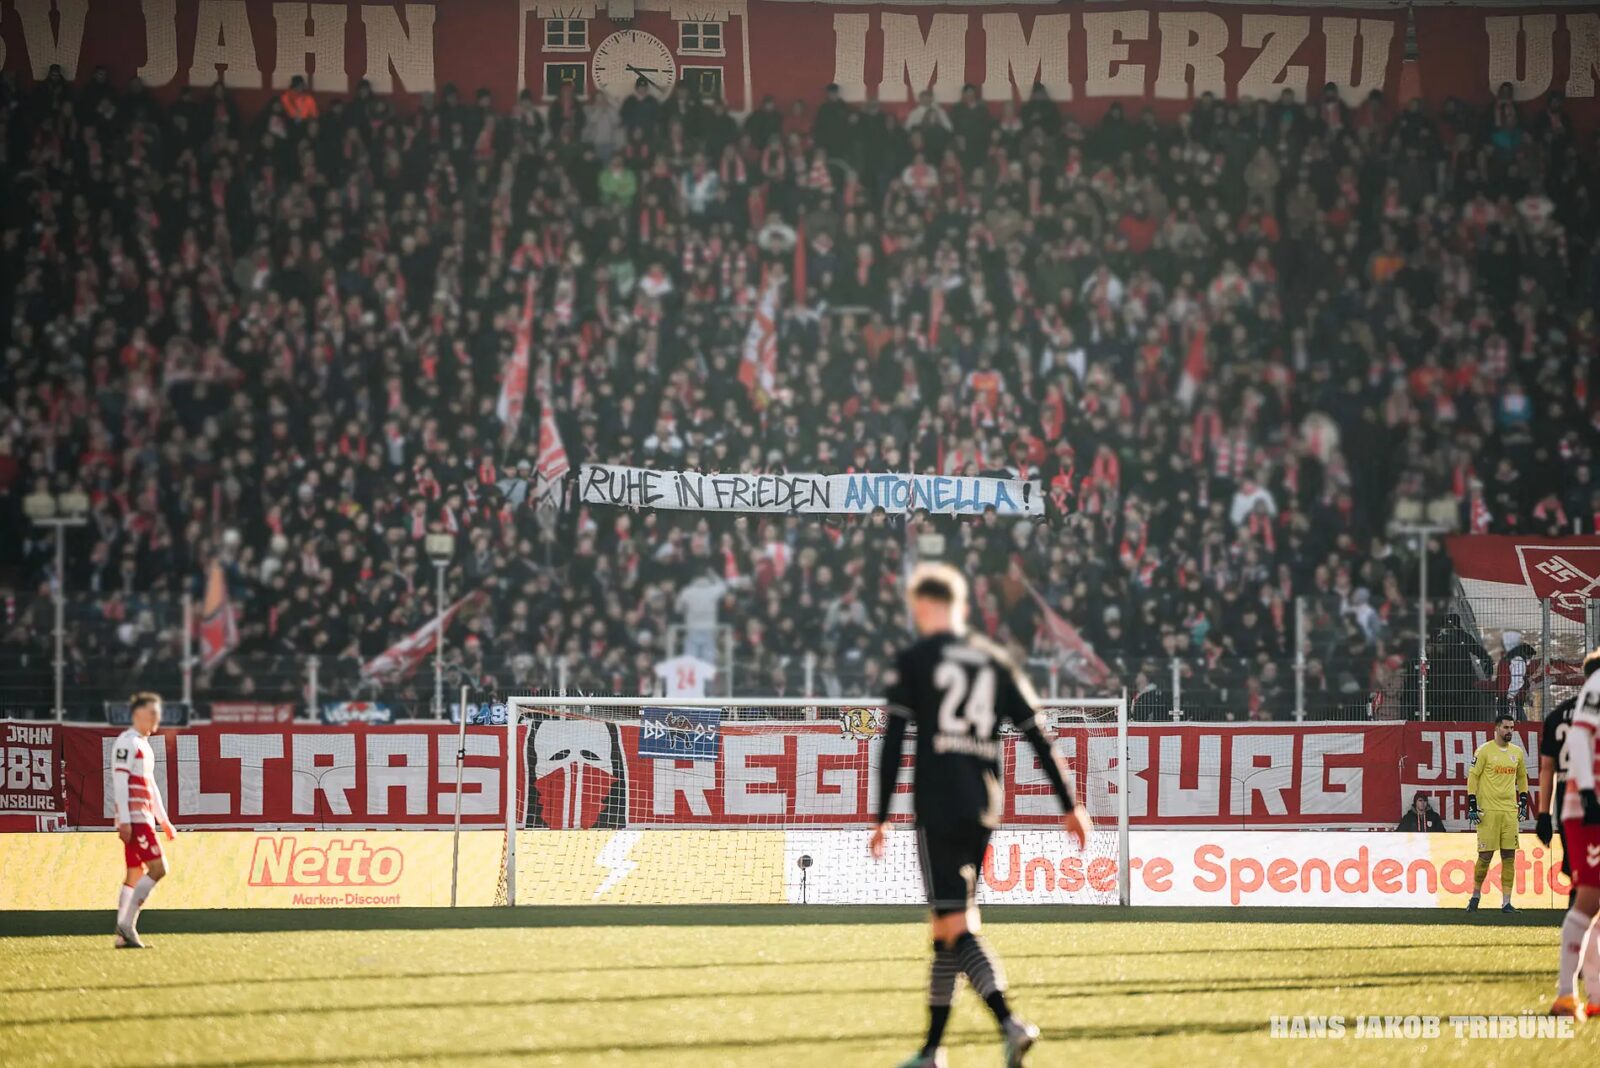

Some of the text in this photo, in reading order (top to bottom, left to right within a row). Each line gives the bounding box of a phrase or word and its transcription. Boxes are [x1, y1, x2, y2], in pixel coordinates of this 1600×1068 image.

[0, 0, 435, 94] V JAHN
[833, 10, 1395, 106] IMMERZU
[583, 466, 664, 504] RUHE
[934, 659, 998, 742] 24
[7, 725, 53, 745] JAHN
[0, 747, 53, 791] 89
[248, 836, 404, 887] Netto
